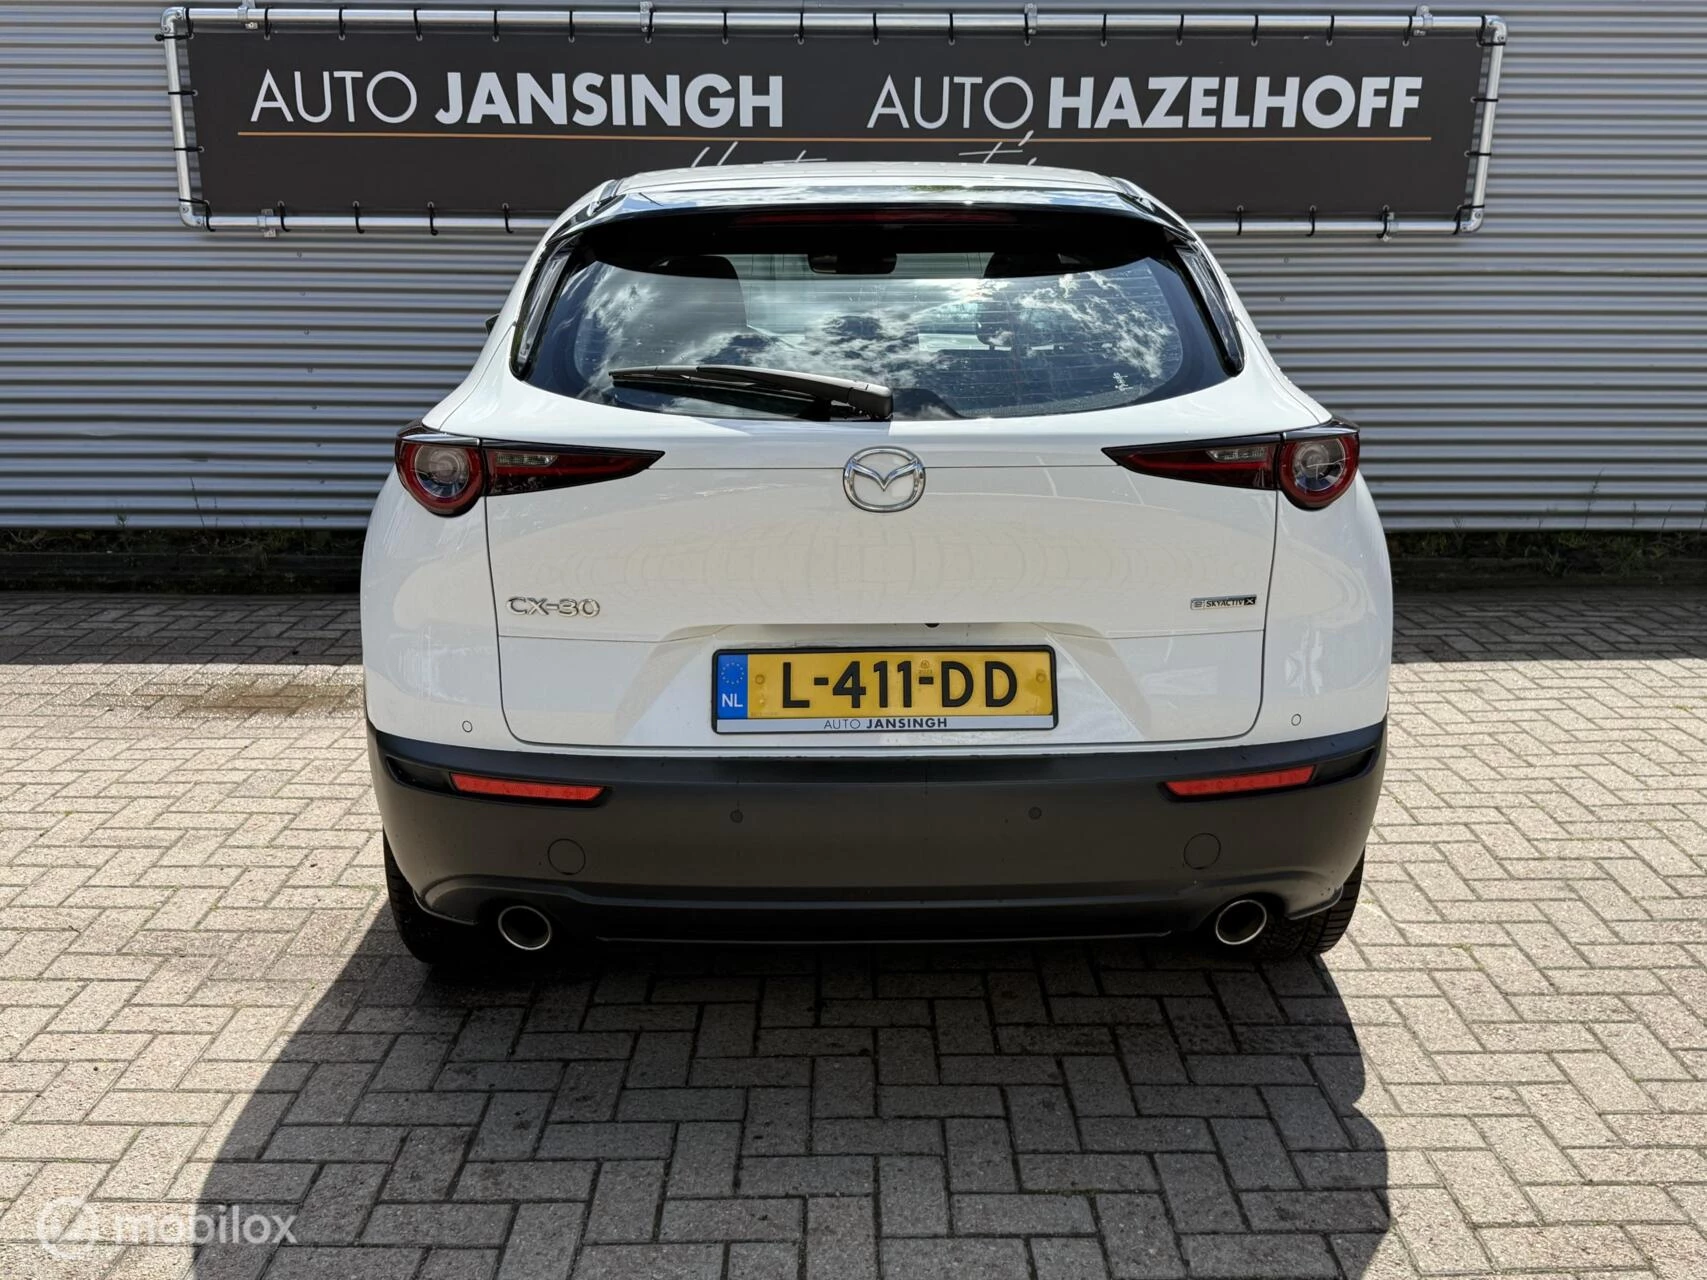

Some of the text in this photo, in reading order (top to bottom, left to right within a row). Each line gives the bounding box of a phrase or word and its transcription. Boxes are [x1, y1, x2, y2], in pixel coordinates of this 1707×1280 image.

[250, 69, 784, 128] AUTO JANSINGH
[866, 73, 1423, 130] AUTO HAZELHOFF
[506, 597, 600, 618] CX-30
[721, 693, 744, 708] NL
[782, 660, 1018, 709] L-411-DD
[823, 717, 948, 730] AUTO JANSINGH
